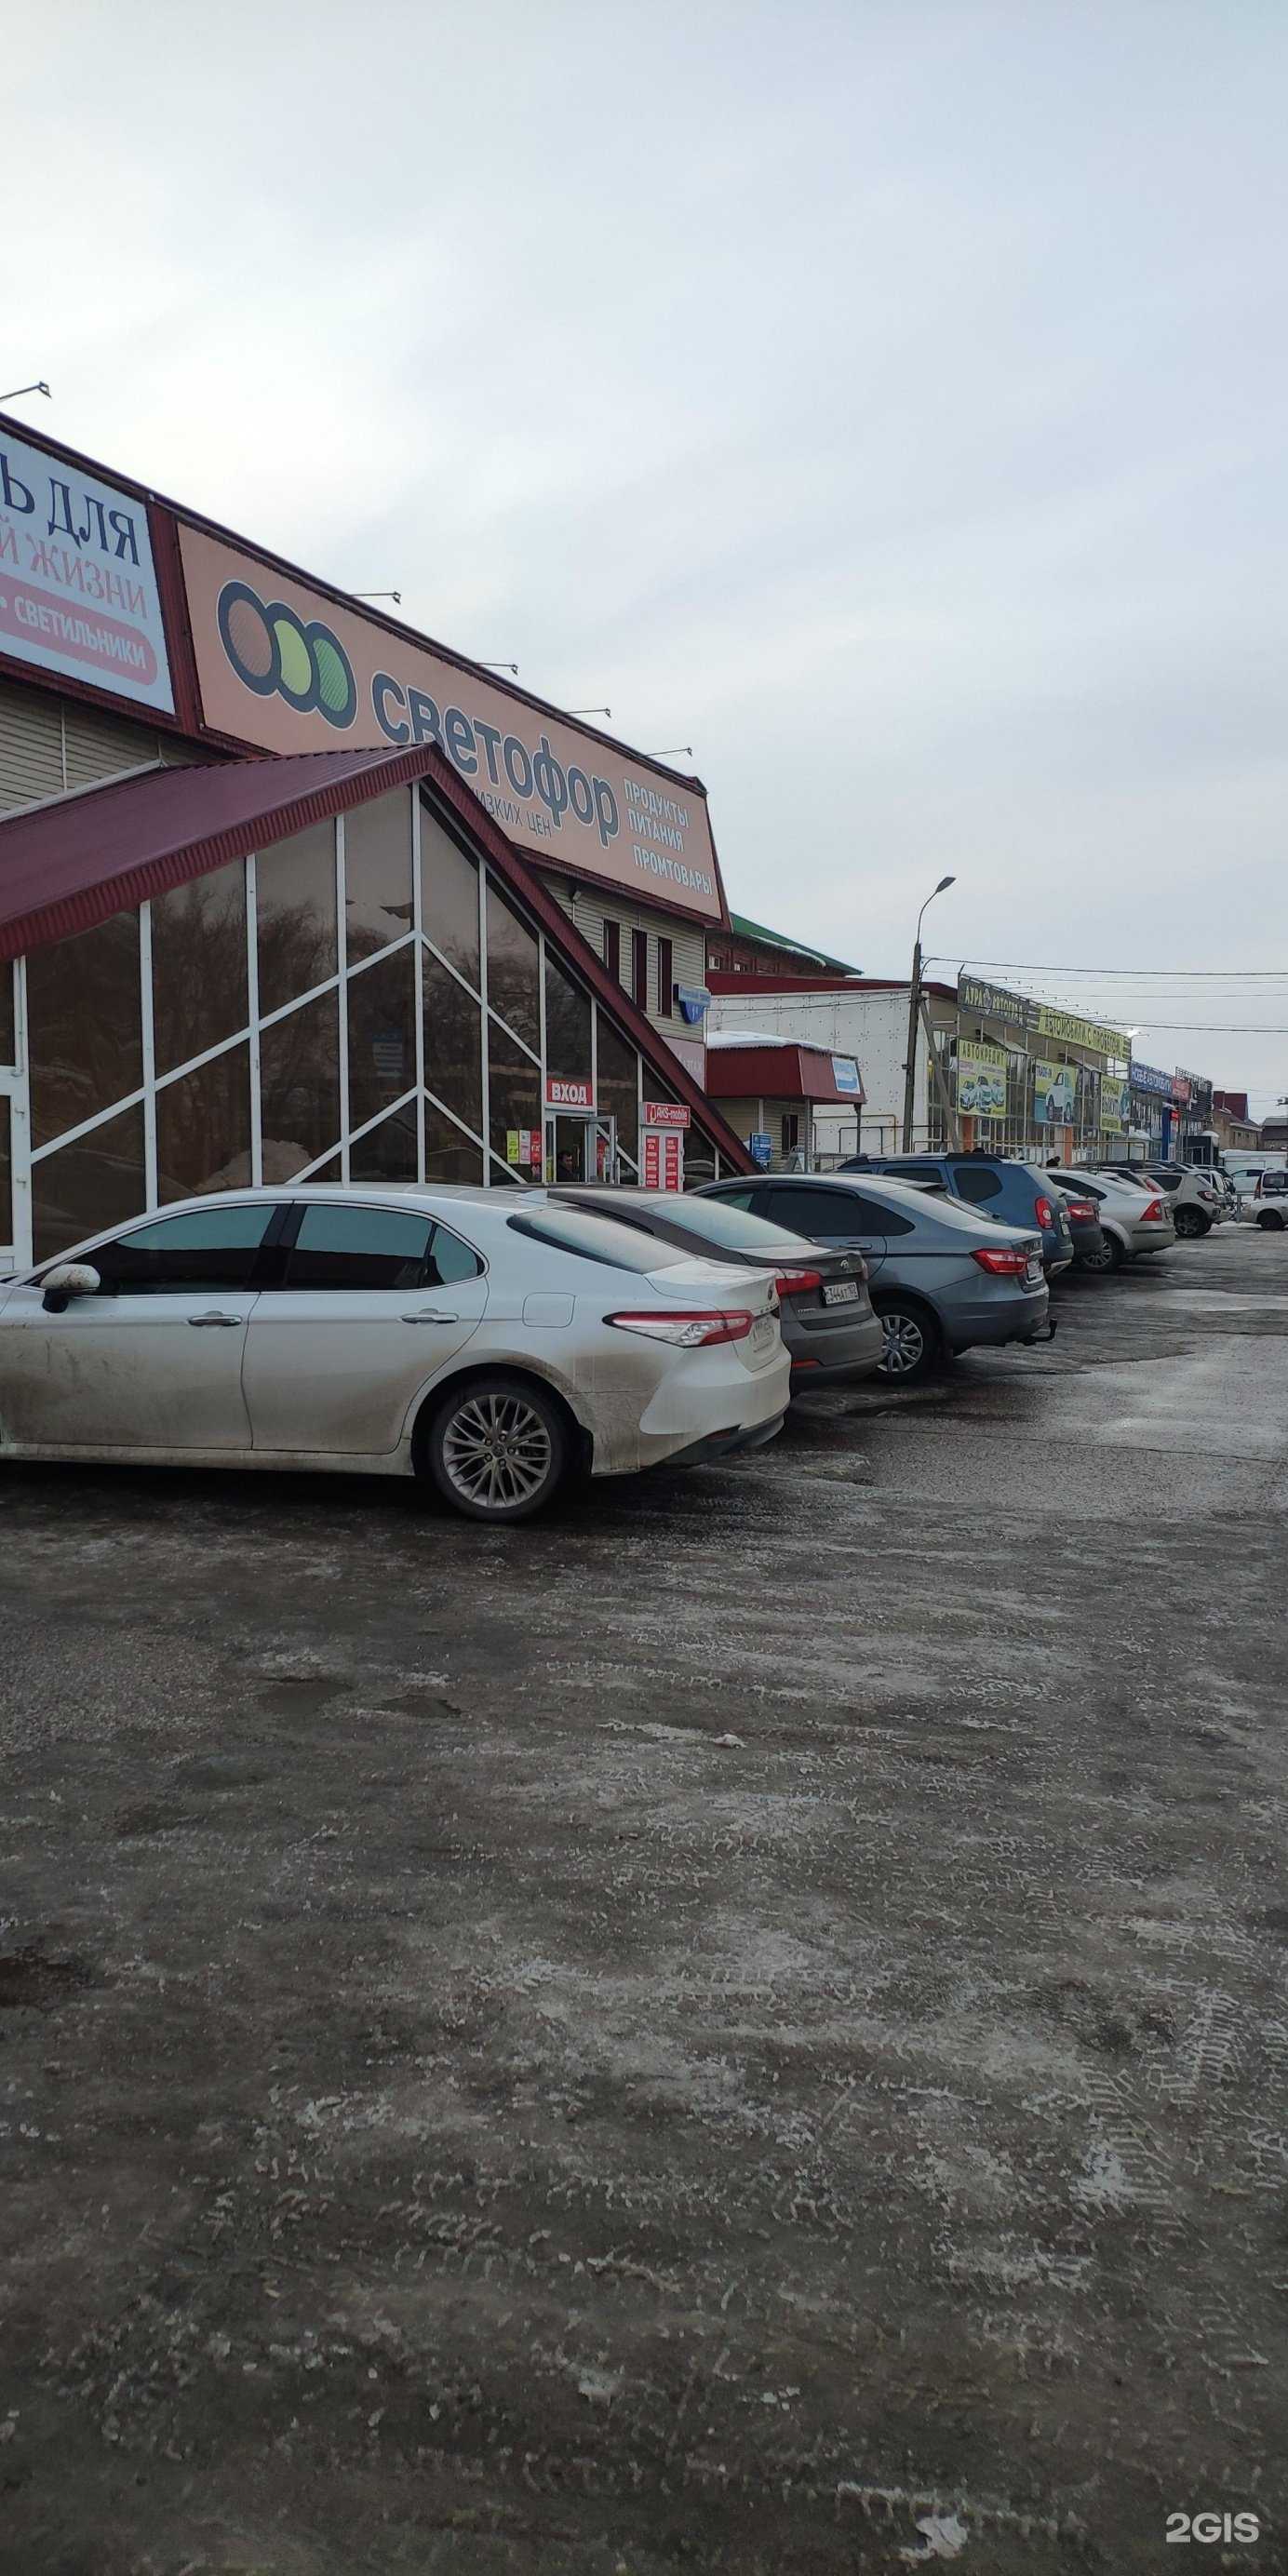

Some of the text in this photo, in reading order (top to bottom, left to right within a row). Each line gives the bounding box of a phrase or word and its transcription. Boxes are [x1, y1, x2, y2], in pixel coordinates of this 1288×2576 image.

[47, 476, 141, 567] ДЛЯ
[25, 532, 148, 620] ЖИЗНИ
[14, 595, 147, 670] СВЕТИЛЬНИКИ
[473, 788, 552, 839] ИЗКИХ ЦЕН
[624, 777, 690, 828] ПРОДУКТЫ
[628, 808, 685, 853] ПИТАНИЯ
[633, 842, 713, 895] ПРОМТОВАРЫ
[551, 1082, 587, 1105] ВХОД
